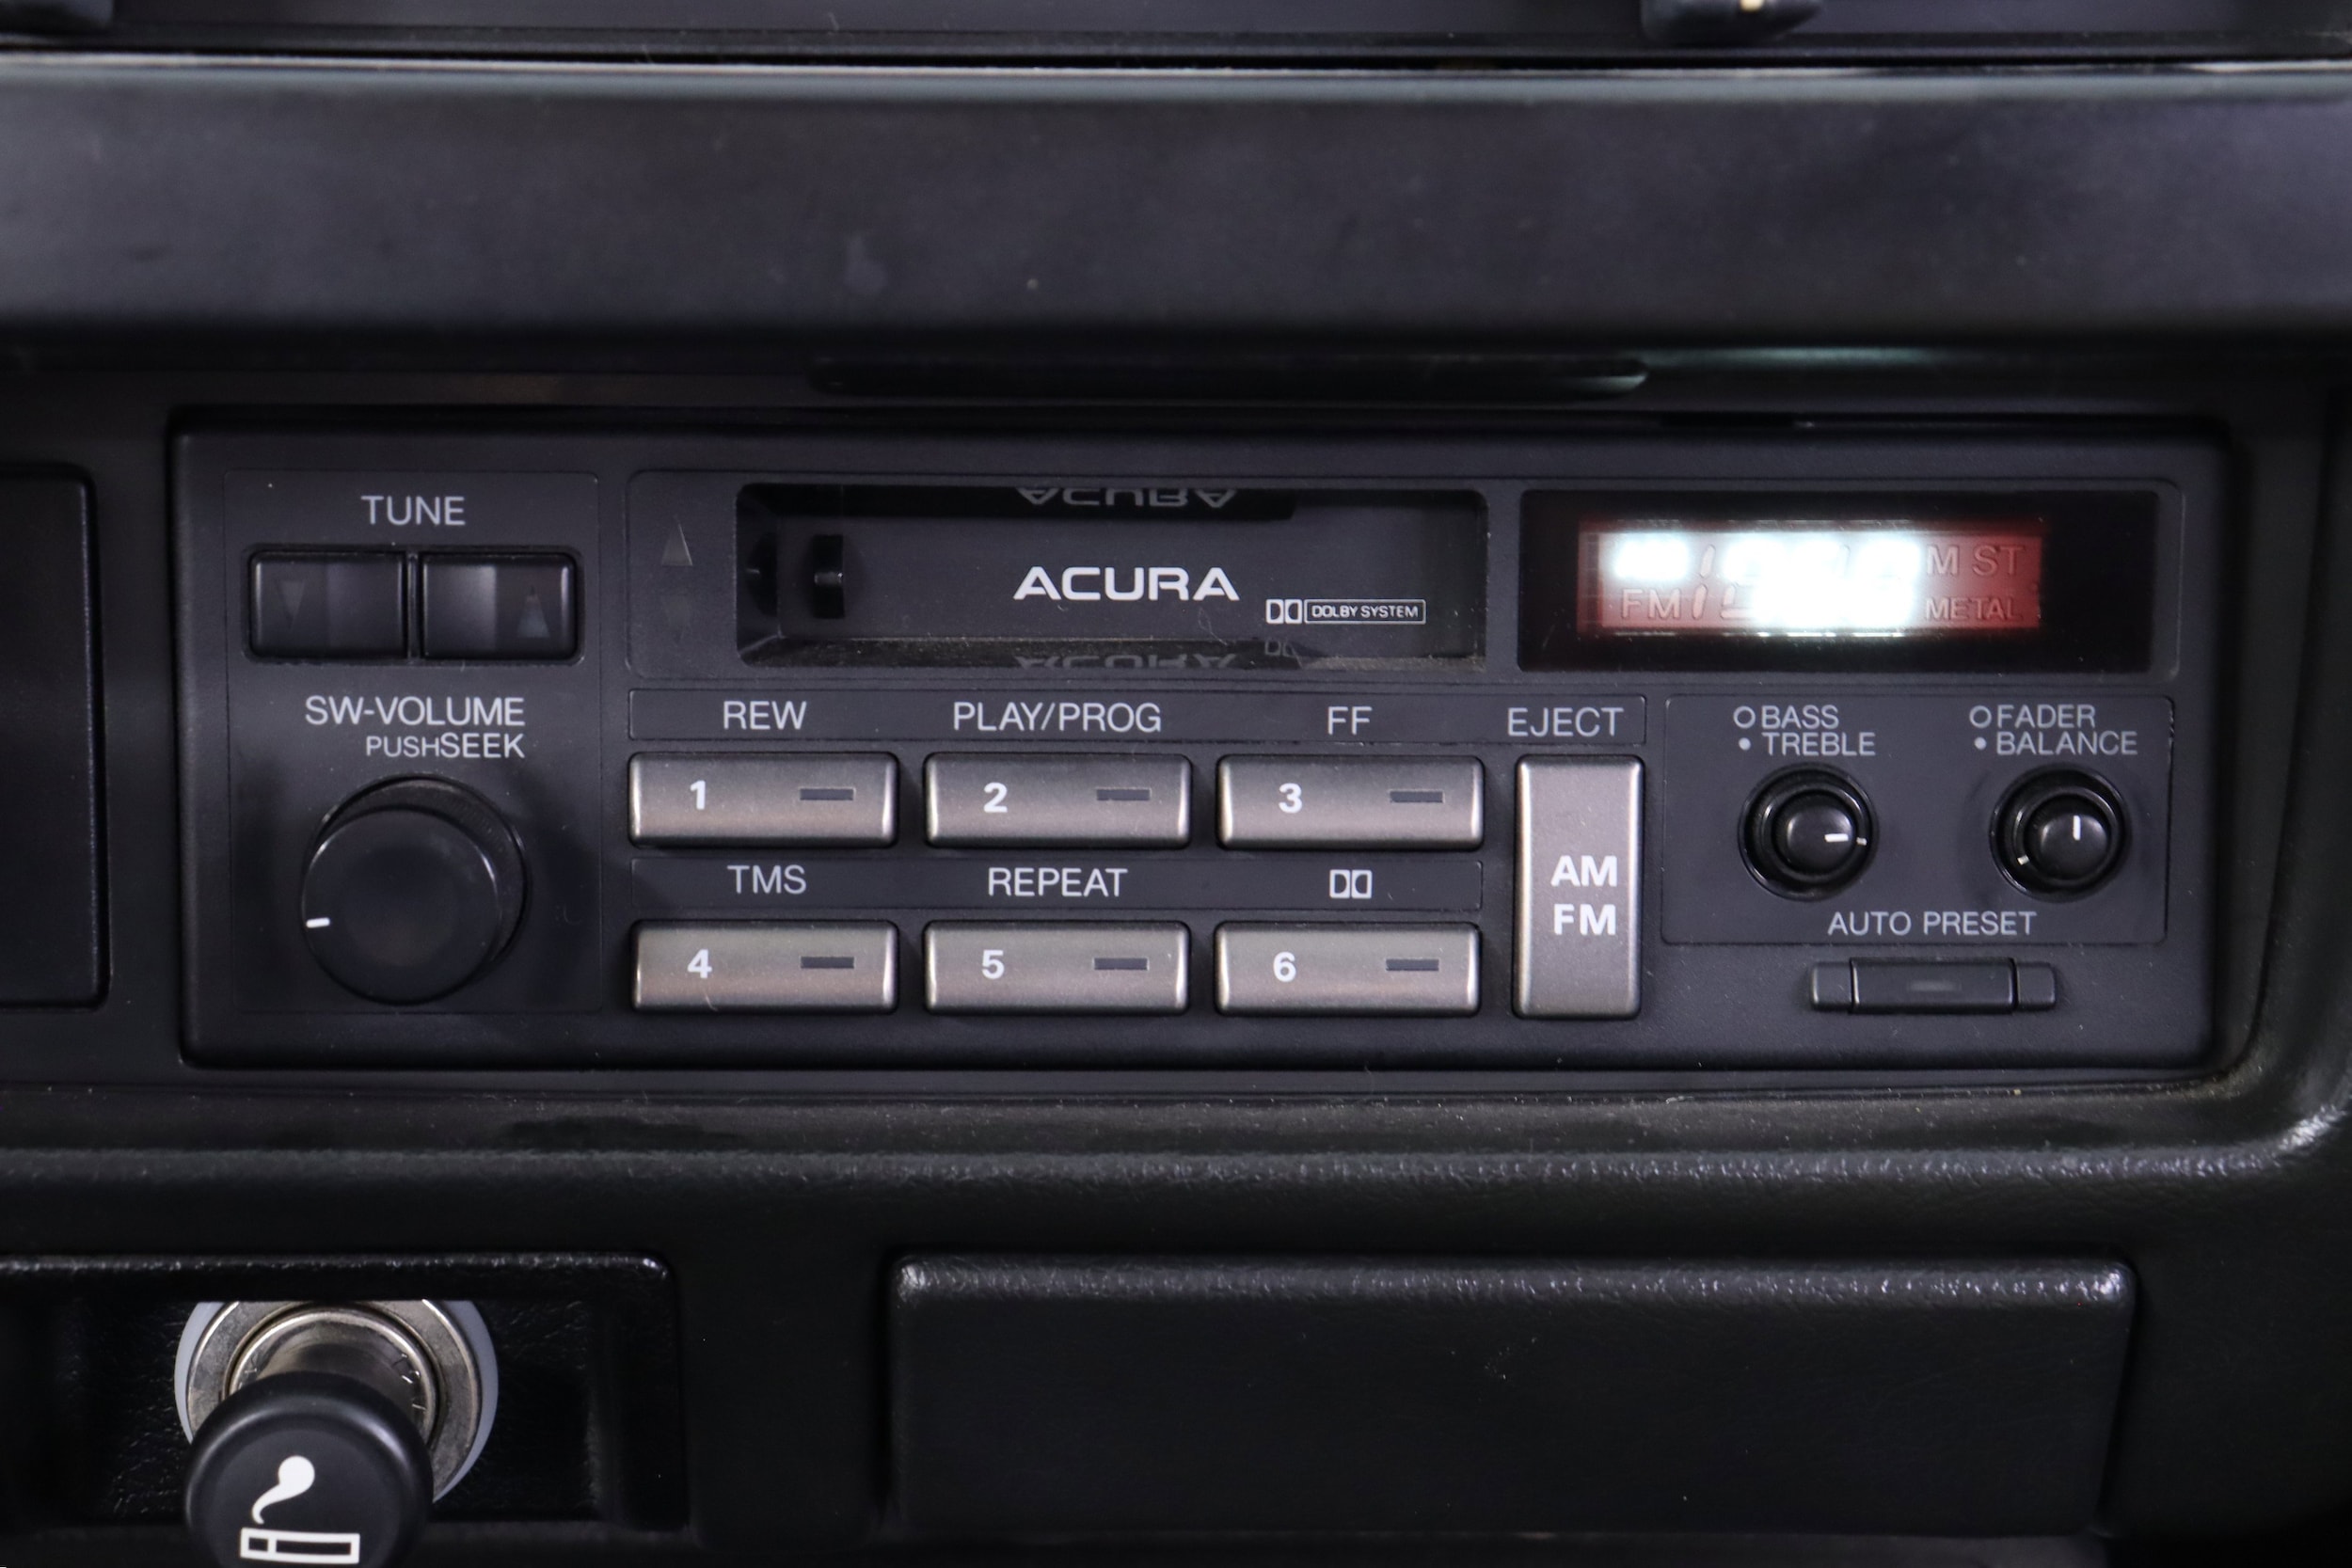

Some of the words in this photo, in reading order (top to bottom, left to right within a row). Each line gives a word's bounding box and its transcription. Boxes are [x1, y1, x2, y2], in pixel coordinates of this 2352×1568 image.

[360, 495, 466, 526] TUNE
[1973, 544, 2025, 576] ST
[1013, 566, 1240, 601] ACURA
[1311, 605, 1359, 618] DOLBY
[1360, 605, 1419, 618] SYSTEM
[1621, 587, 1681, 619] FM
[1925, 596, 2023, 621] METAL
[305, 694, 526, 726] SW-VOLUME
[723, 700, 807, 730] REW
[953, 701, 1162, 733] PLAY/PROG
[1327, 705, 1373, 736] FF
[1507, 706, 1625, 737] EJECT
[1761, 704, 1839, 730] BASS
[1996, 704, 2096, 729] FADER
[1761, 731, 1876, 756] TREBLE
[1996, 730, 2137, 755] BALANCE
[690, 780, 707, 811] 1
[983, 782, 1009, 814] 2
[1278, 783, 1303, 815] 3
[726, 863, 807, 895] TMS
[988, 866, 1128, 897] REPEAT
[1550, 854, 1618, 887] AM
[1553, 903, 1616, 936] FM
[1827, 911, 1913, 936] AUTO
[1923, 911, 2037, 936] PRESET
[687, 948, 713, 979] 4
[981, 949, 1005, 980] 5
[1273, 951, 1297, 983] 6
